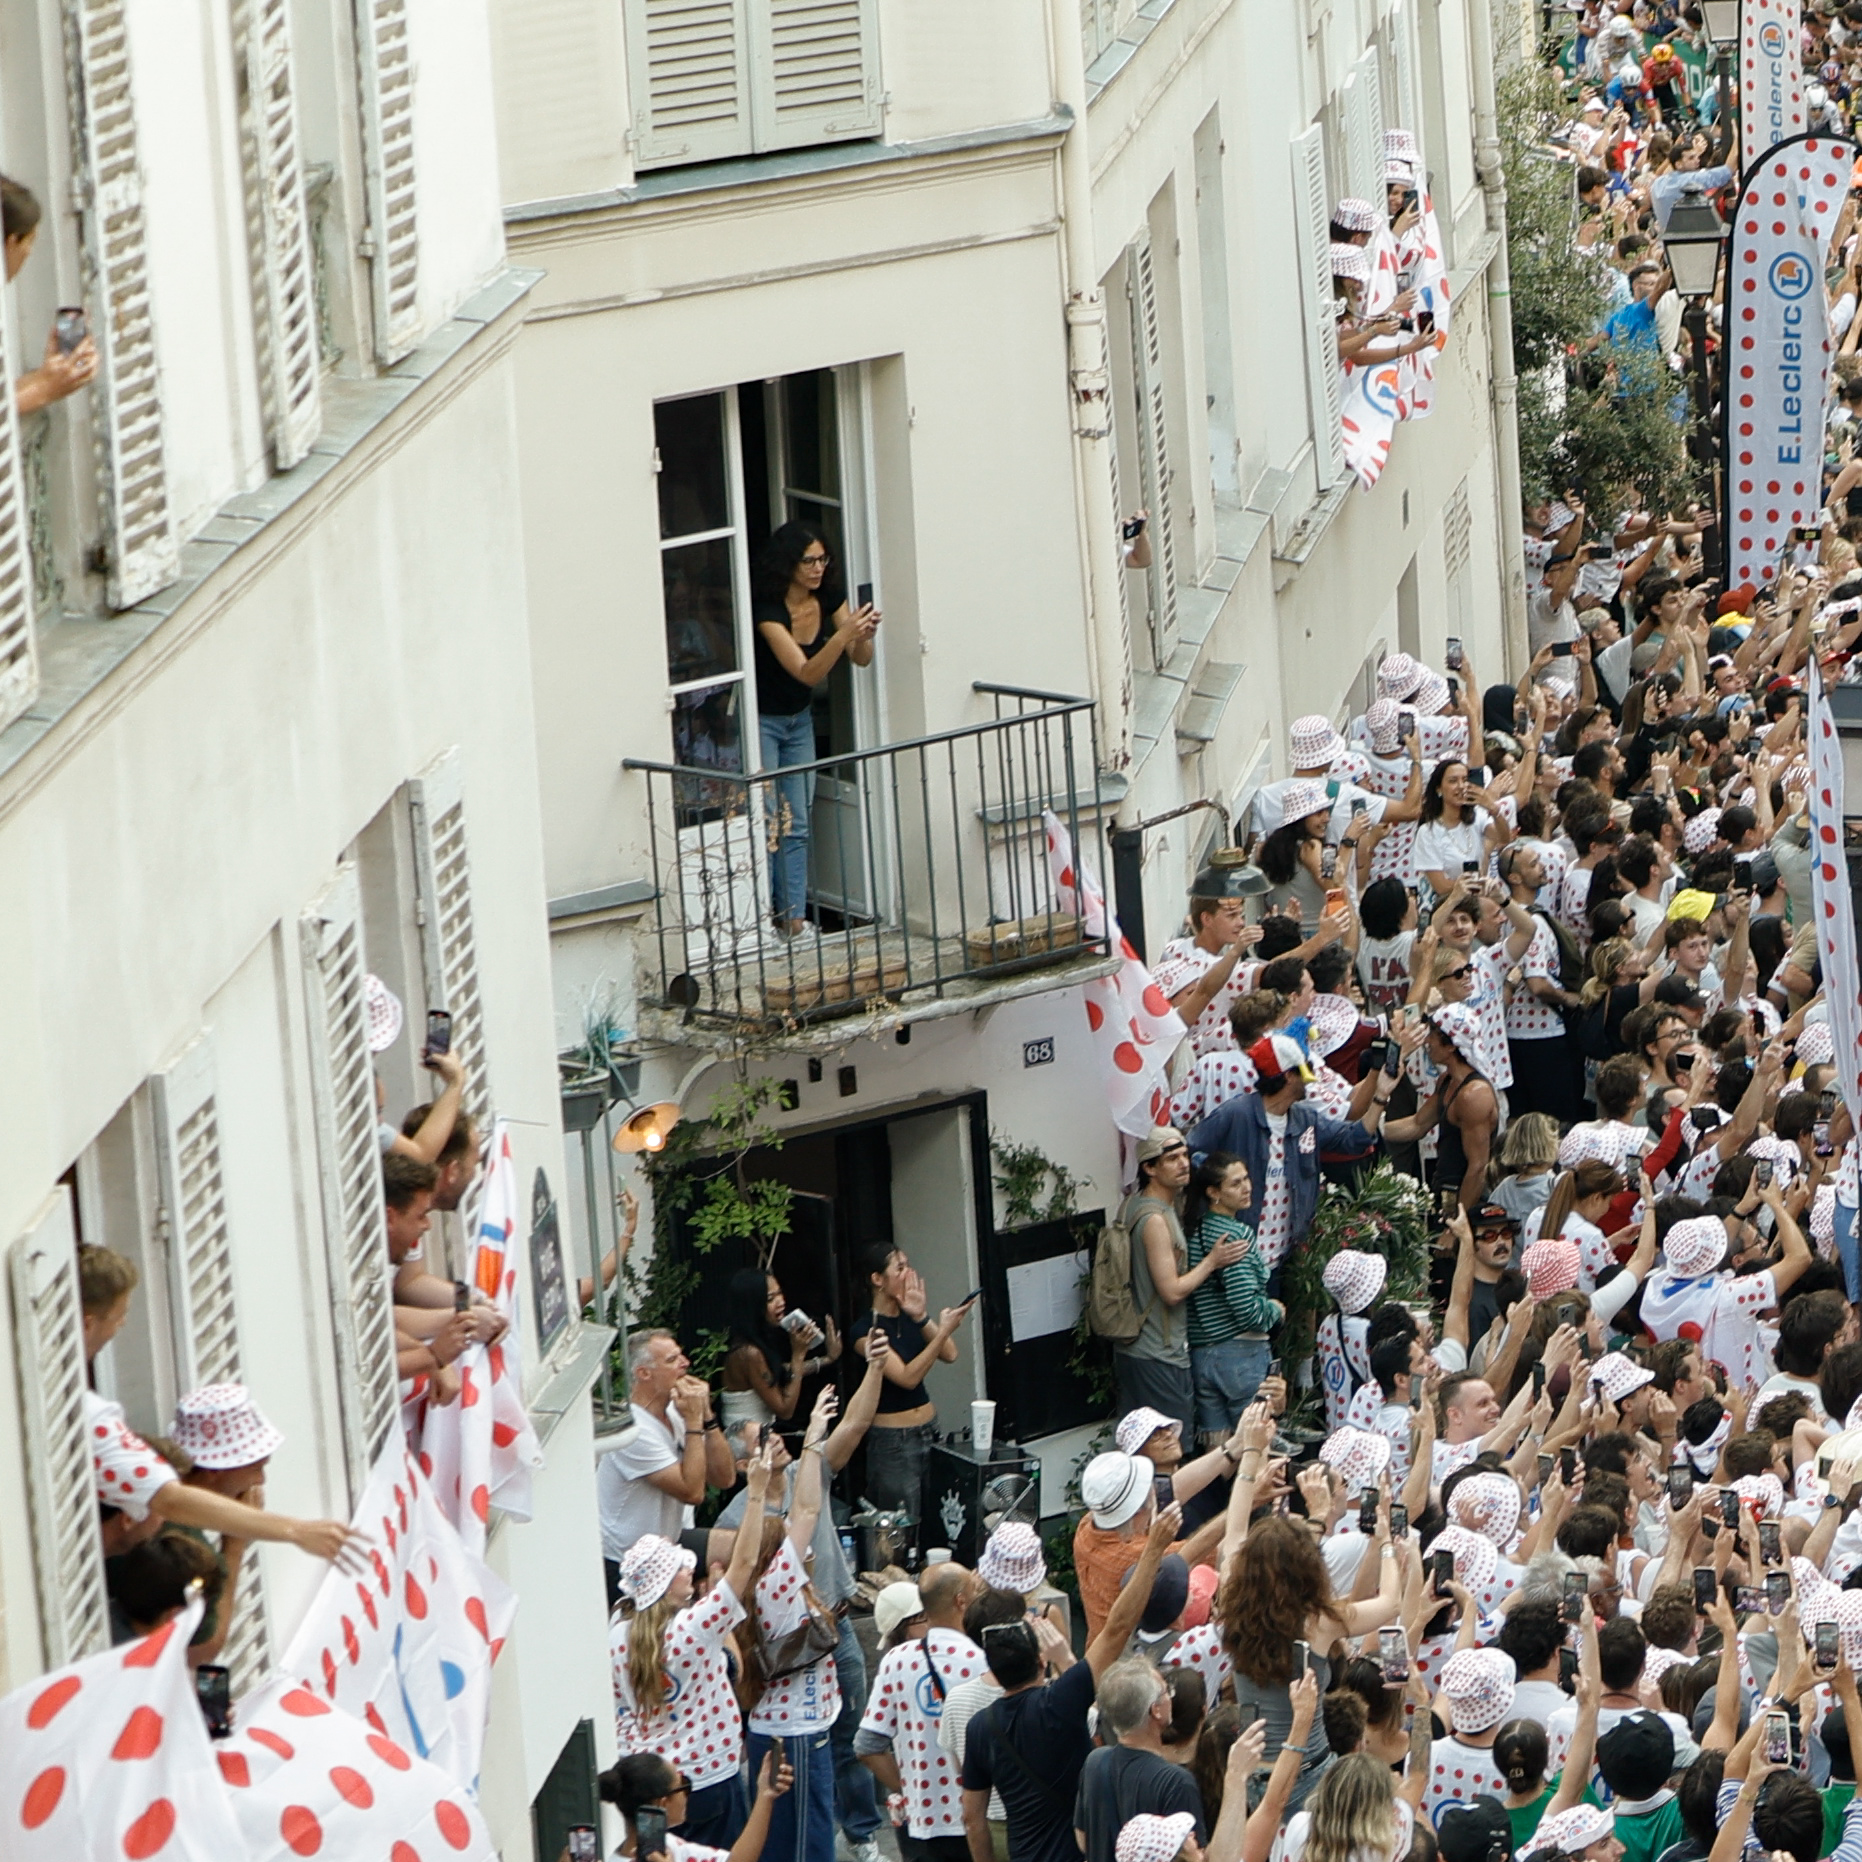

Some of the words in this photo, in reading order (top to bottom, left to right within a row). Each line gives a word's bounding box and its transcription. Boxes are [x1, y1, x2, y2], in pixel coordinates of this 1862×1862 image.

[1769, 61, 1782, 144] eclerc
[1778, 306, 1803, 466] E.Leclerc
[1027, 1042, 1051, 1063] 68
[804, 1662, 817, 1721] E.Lecl
